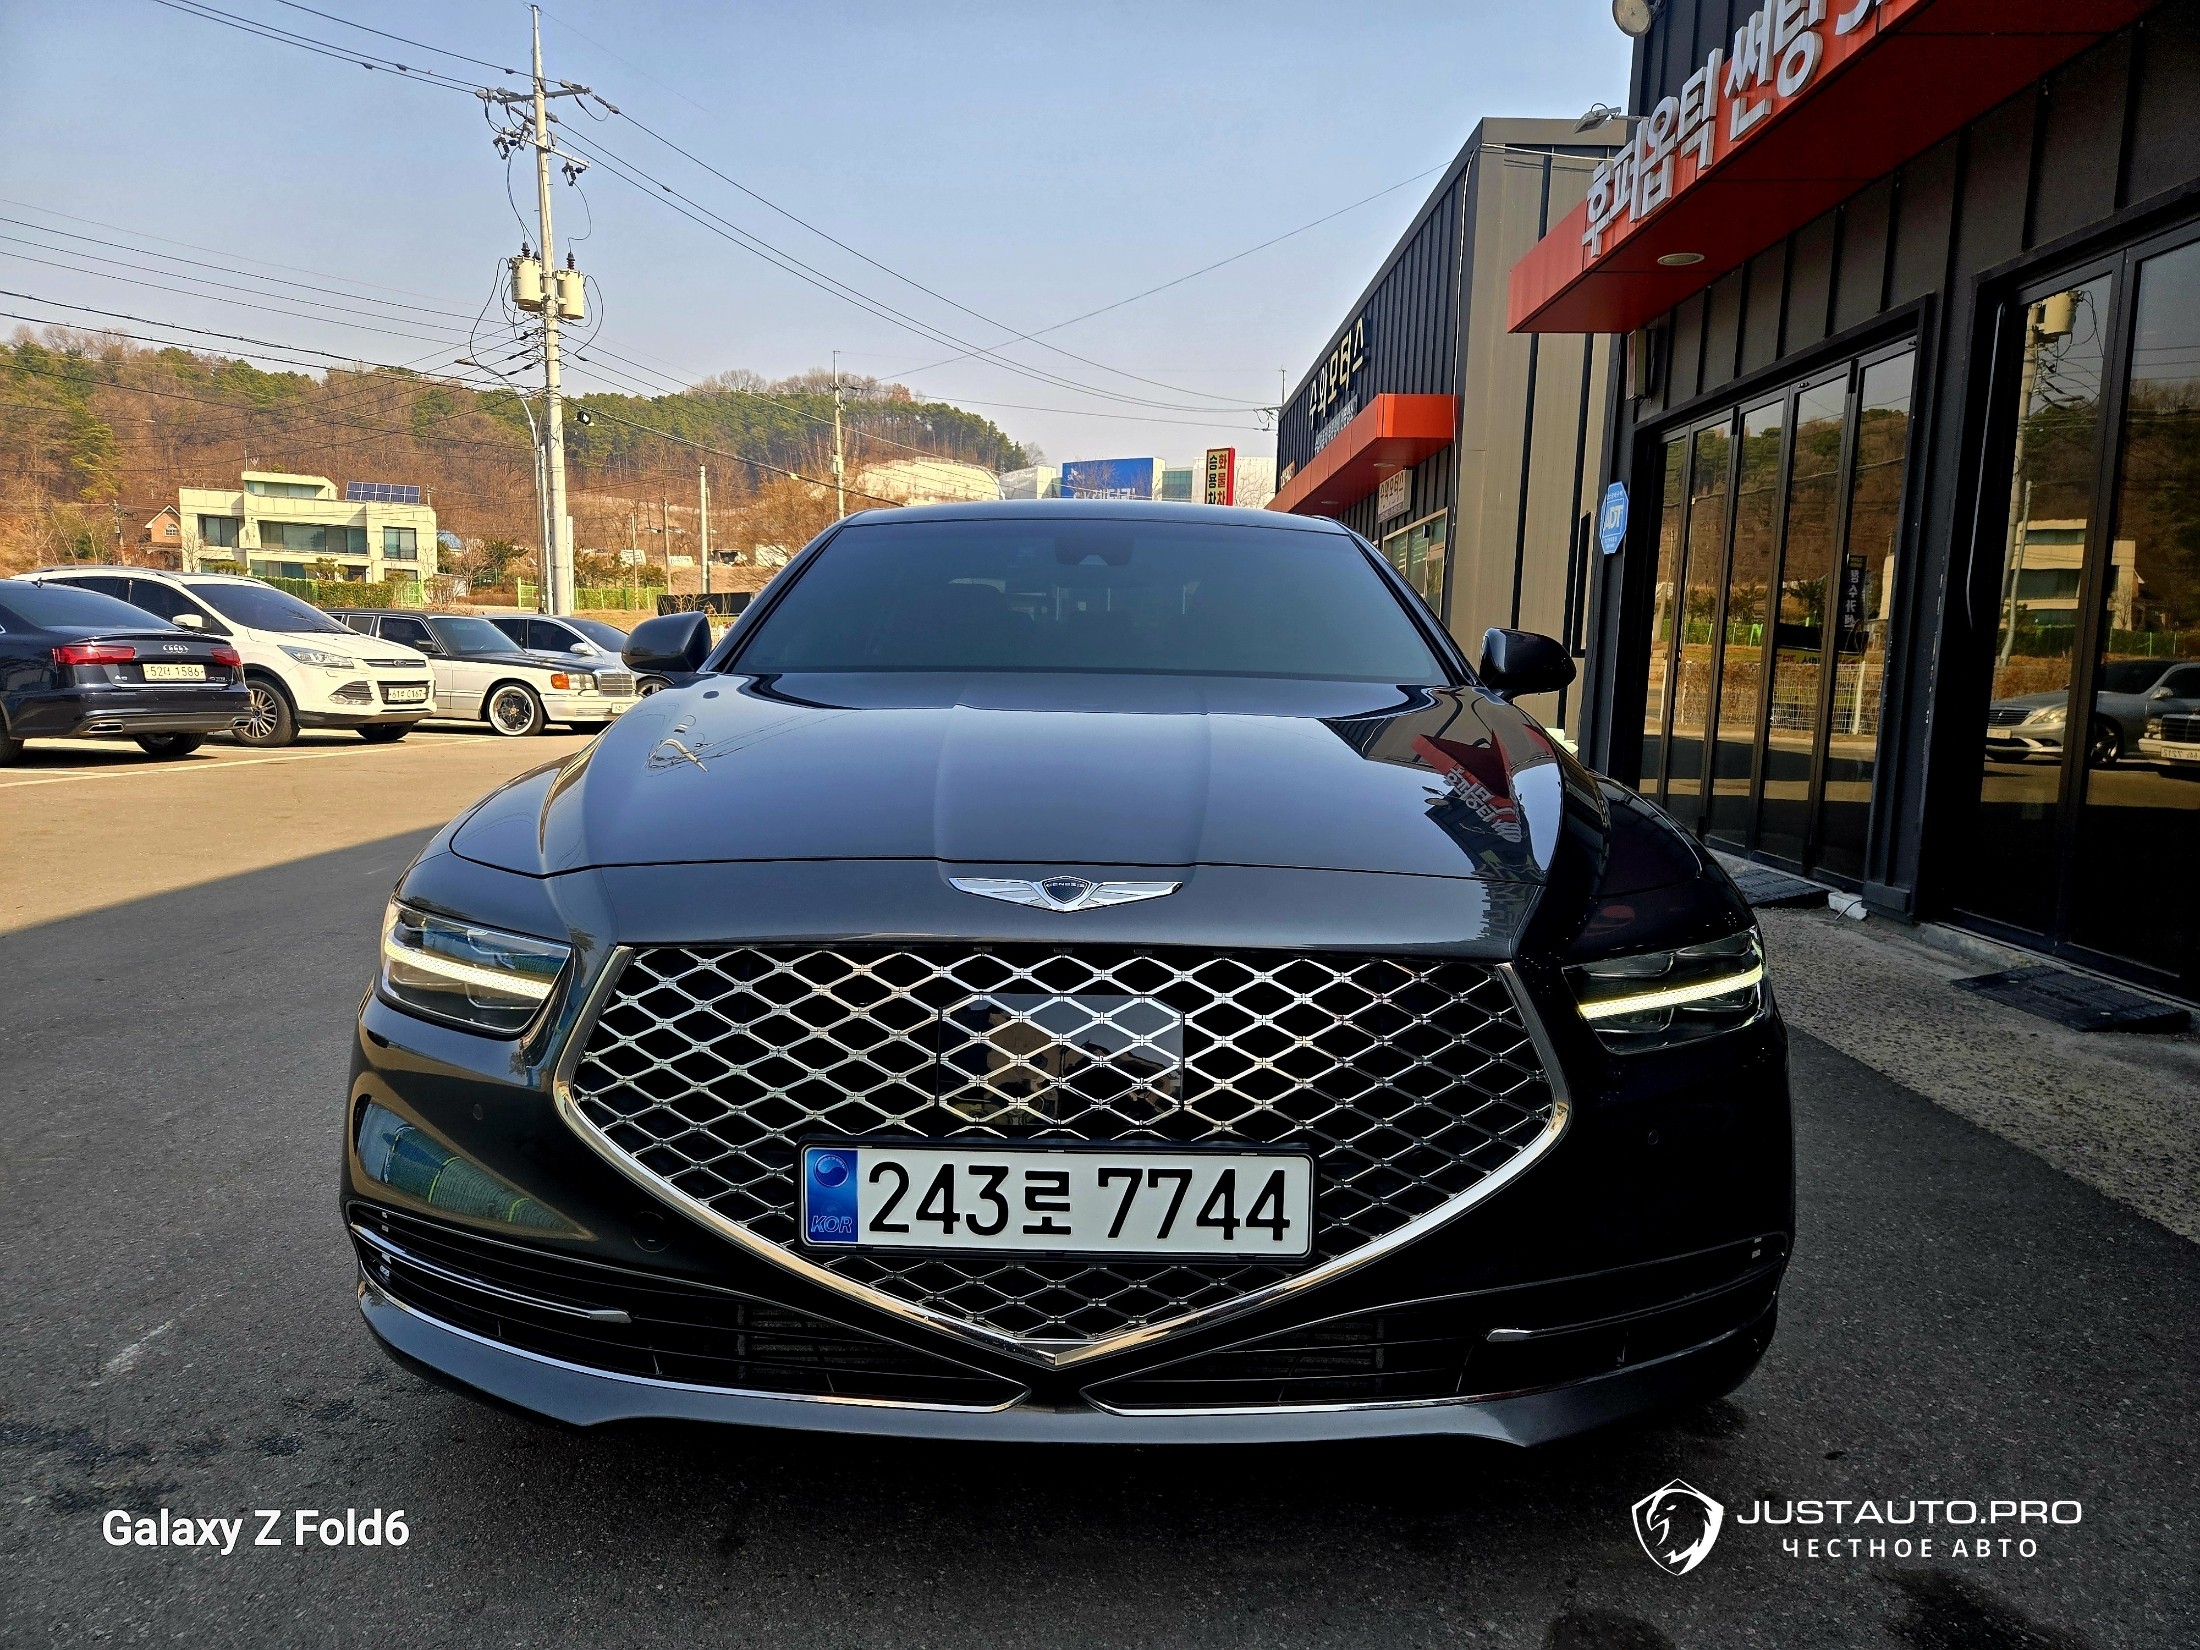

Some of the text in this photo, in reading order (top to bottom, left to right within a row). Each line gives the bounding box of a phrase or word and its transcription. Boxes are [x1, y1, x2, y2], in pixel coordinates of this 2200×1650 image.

[1217, 454, 1227, 505] 화물차
[1605, 505, 1624, 530] ADT
[175, 666, 200, 677] 1586
[868, 1161, 1292, 1242] 243로 7744
[810, 1215, 853, 1234] KOR
